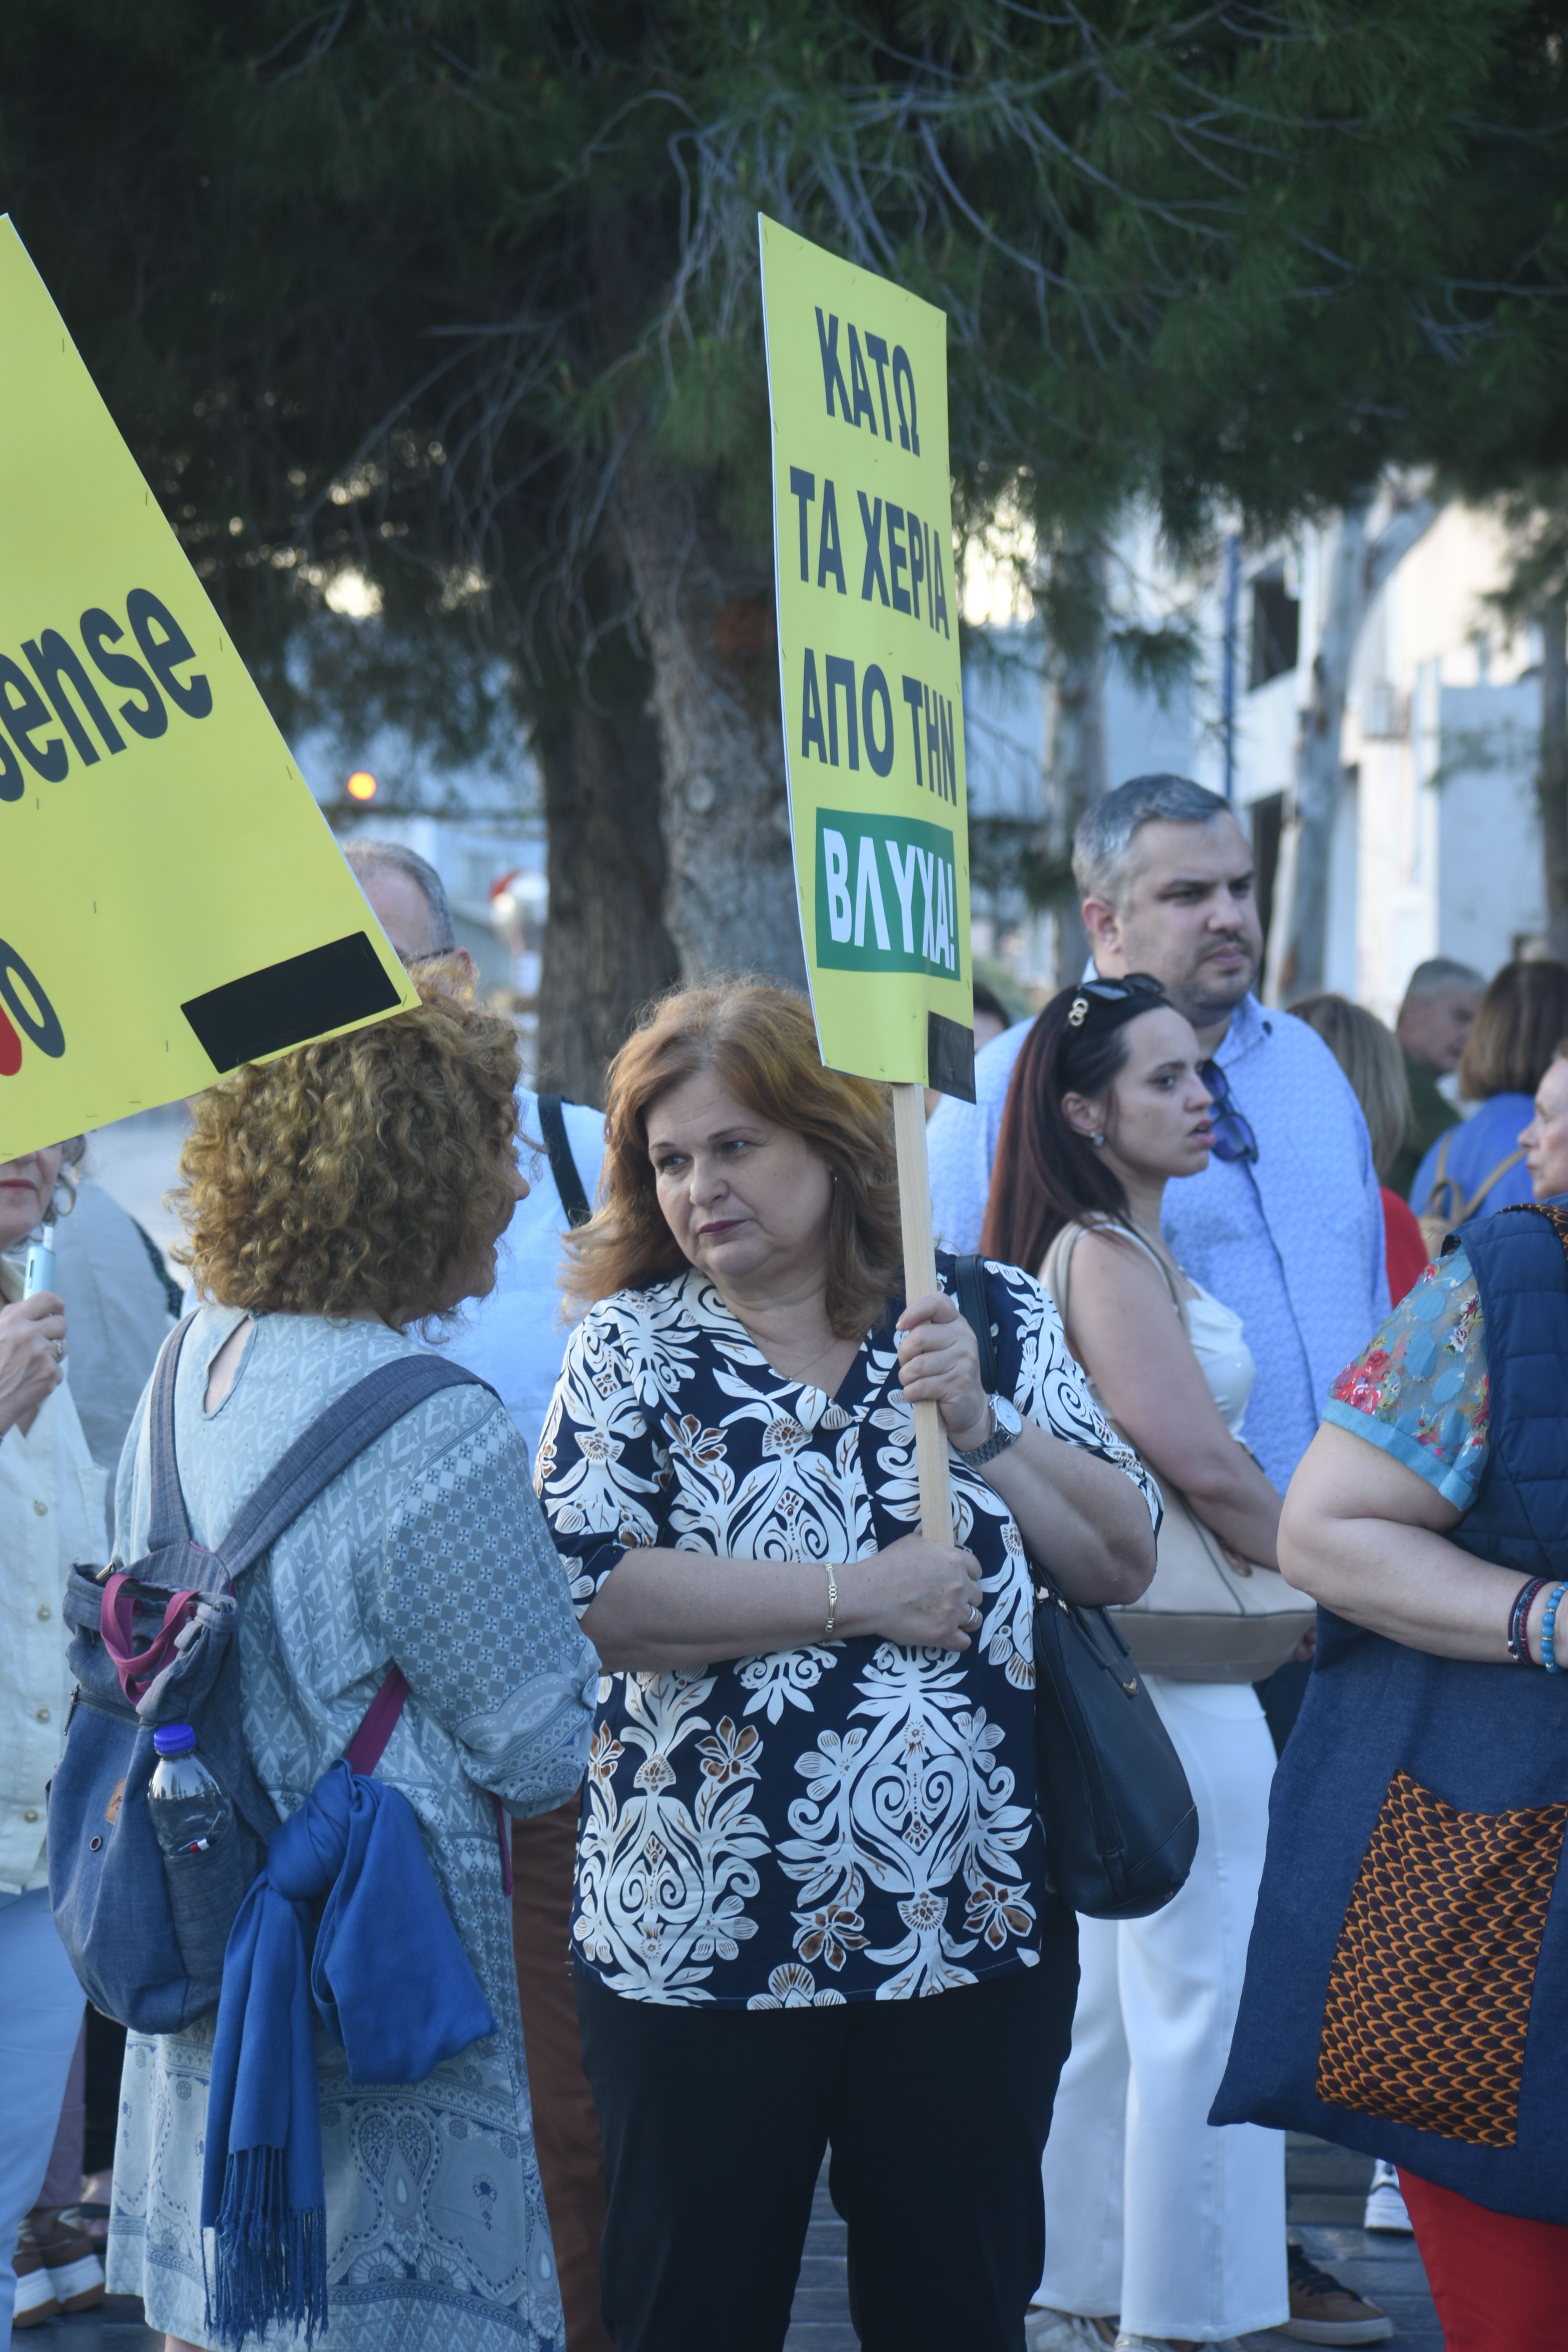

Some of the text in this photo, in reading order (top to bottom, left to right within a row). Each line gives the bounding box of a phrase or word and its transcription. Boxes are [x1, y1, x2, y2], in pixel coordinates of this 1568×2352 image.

[815, 306, 920, 457] ΚΑΤΩ
[790, 466, 950, 640] ΤΑ ΧΕΡΙΑ
[802, 648, 957, 806] ΑΠΟ ΤΗΝ
[823, 828, 955, 971] ΒΛΥΧΑ!
